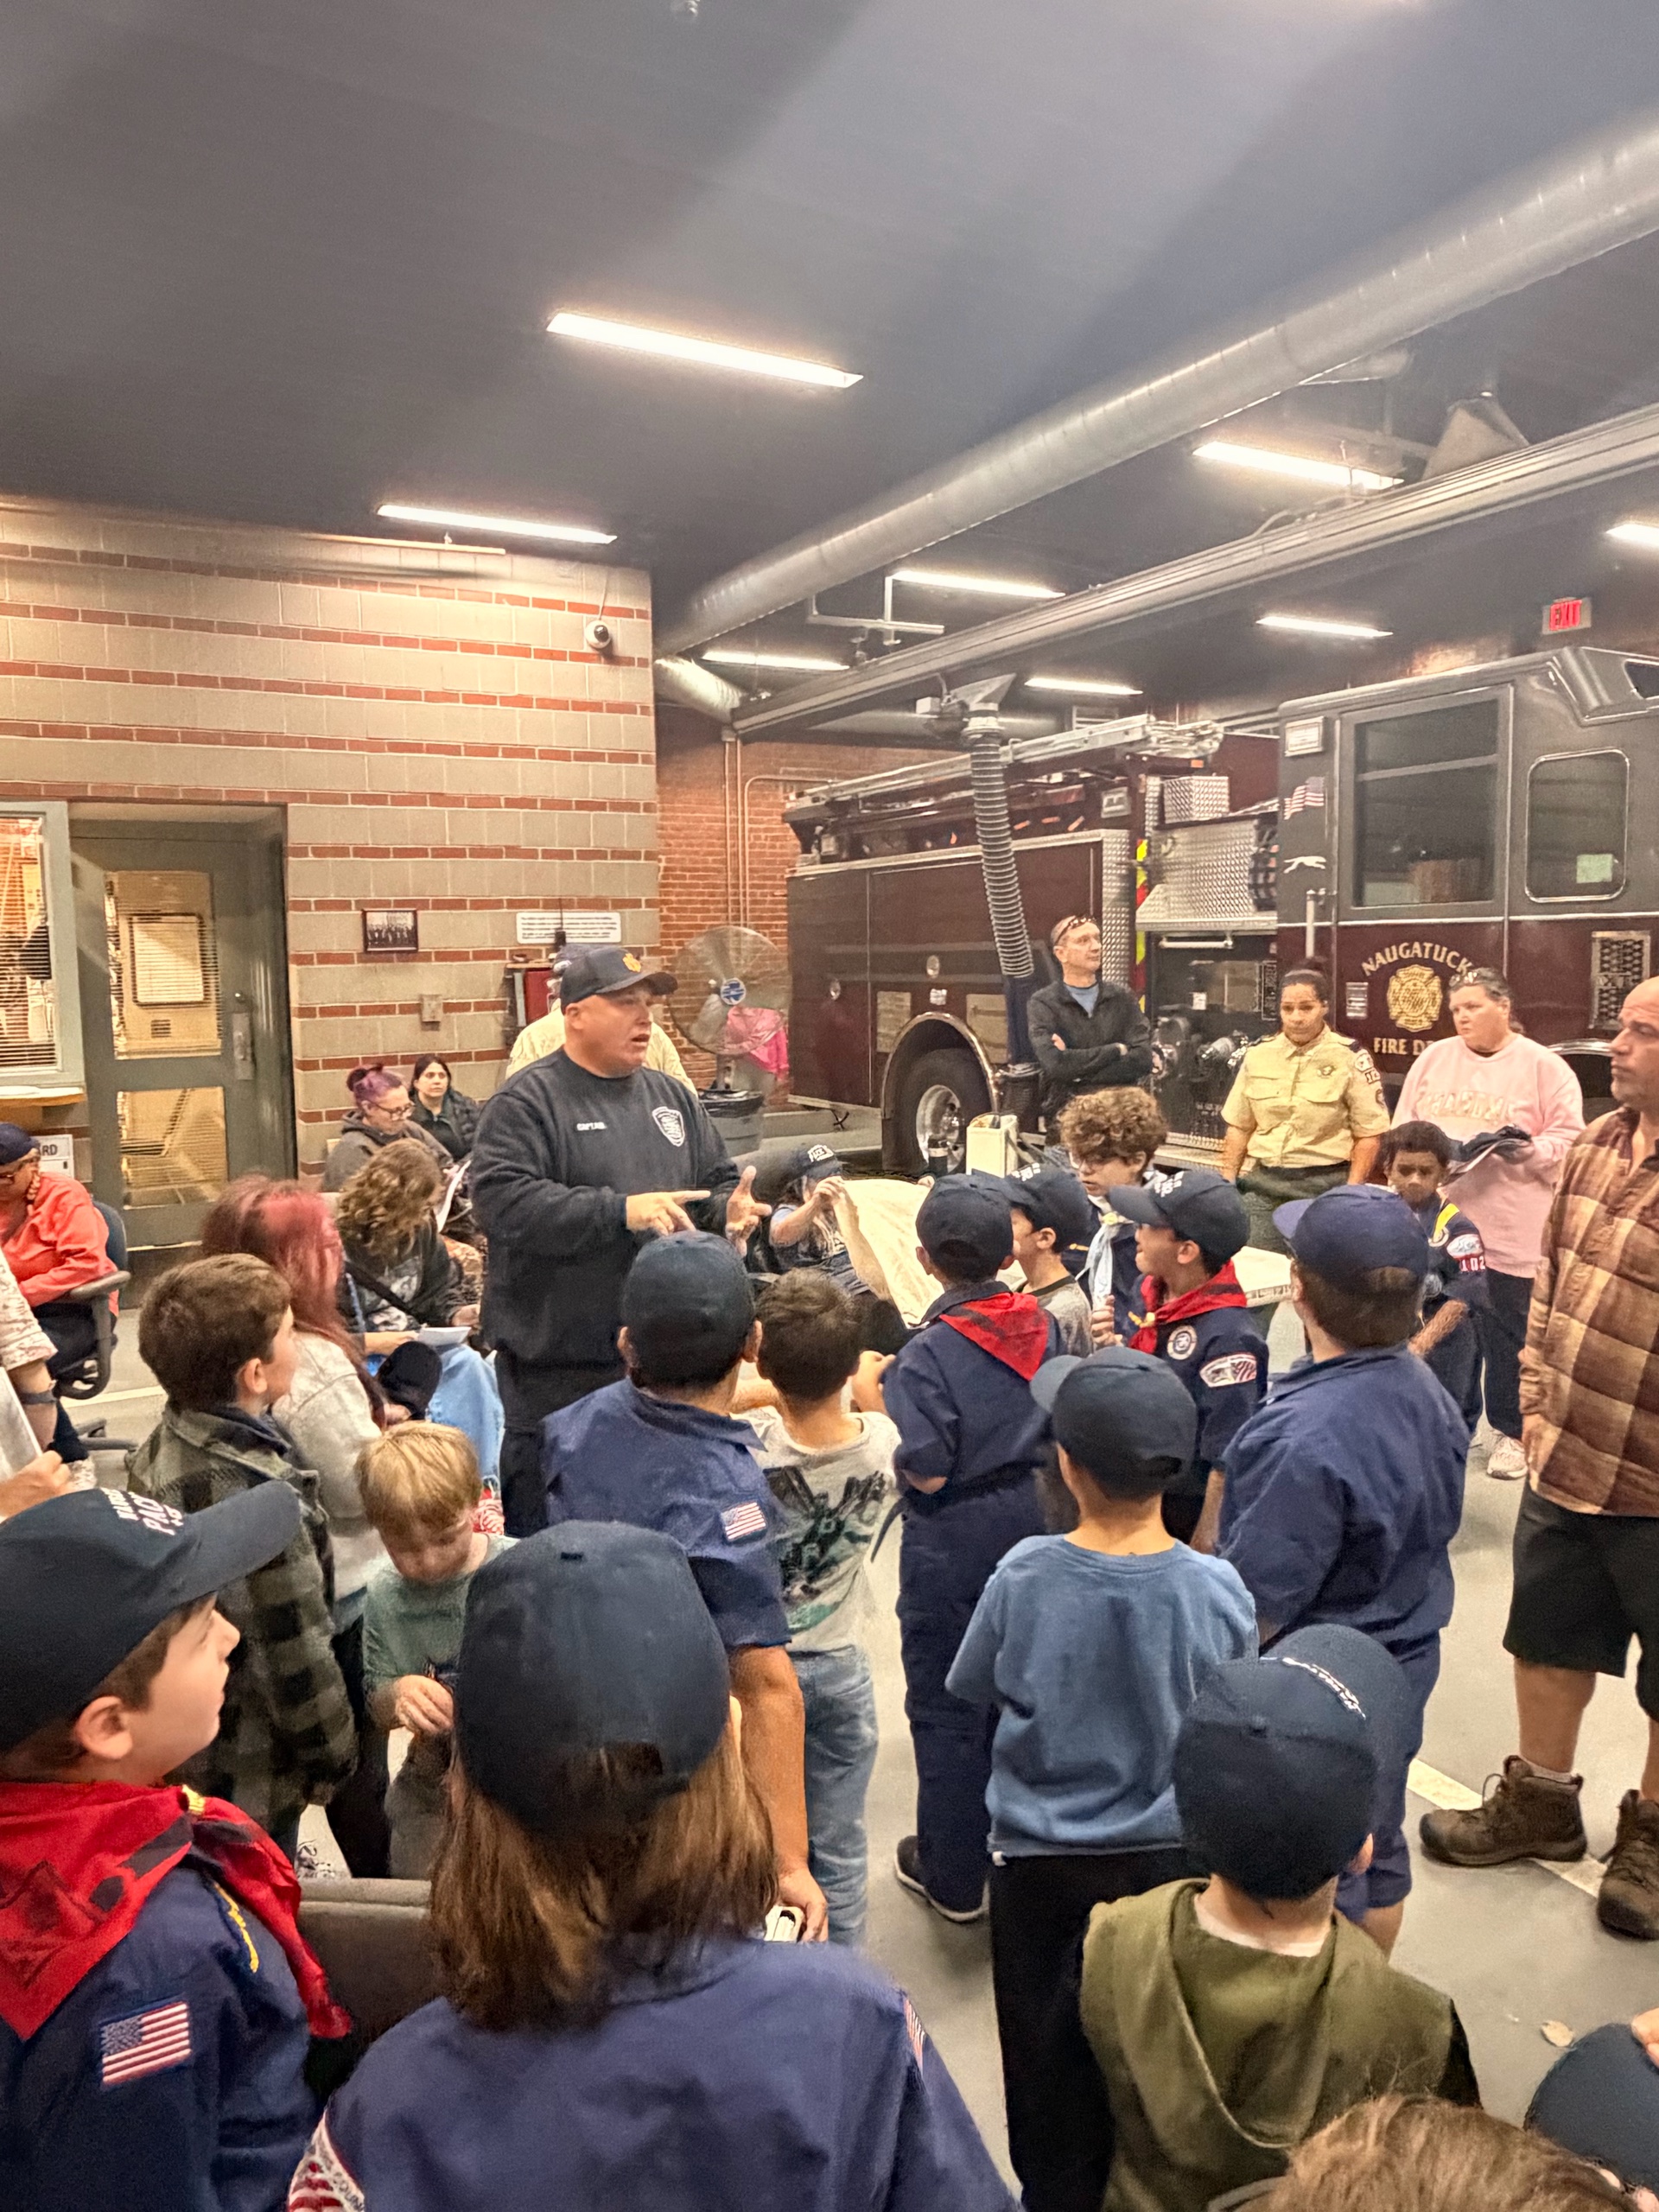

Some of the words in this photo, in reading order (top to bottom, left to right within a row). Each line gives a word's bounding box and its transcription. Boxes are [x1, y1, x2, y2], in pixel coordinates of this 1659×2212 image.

[1549, 600, 1582, 631] EXIT
[1362, 941, 1473, 977] NAUGATUCK
[1374, 1037, 1408, 1054] FIRE
[1459, 1255, 1485, 1272] 102
